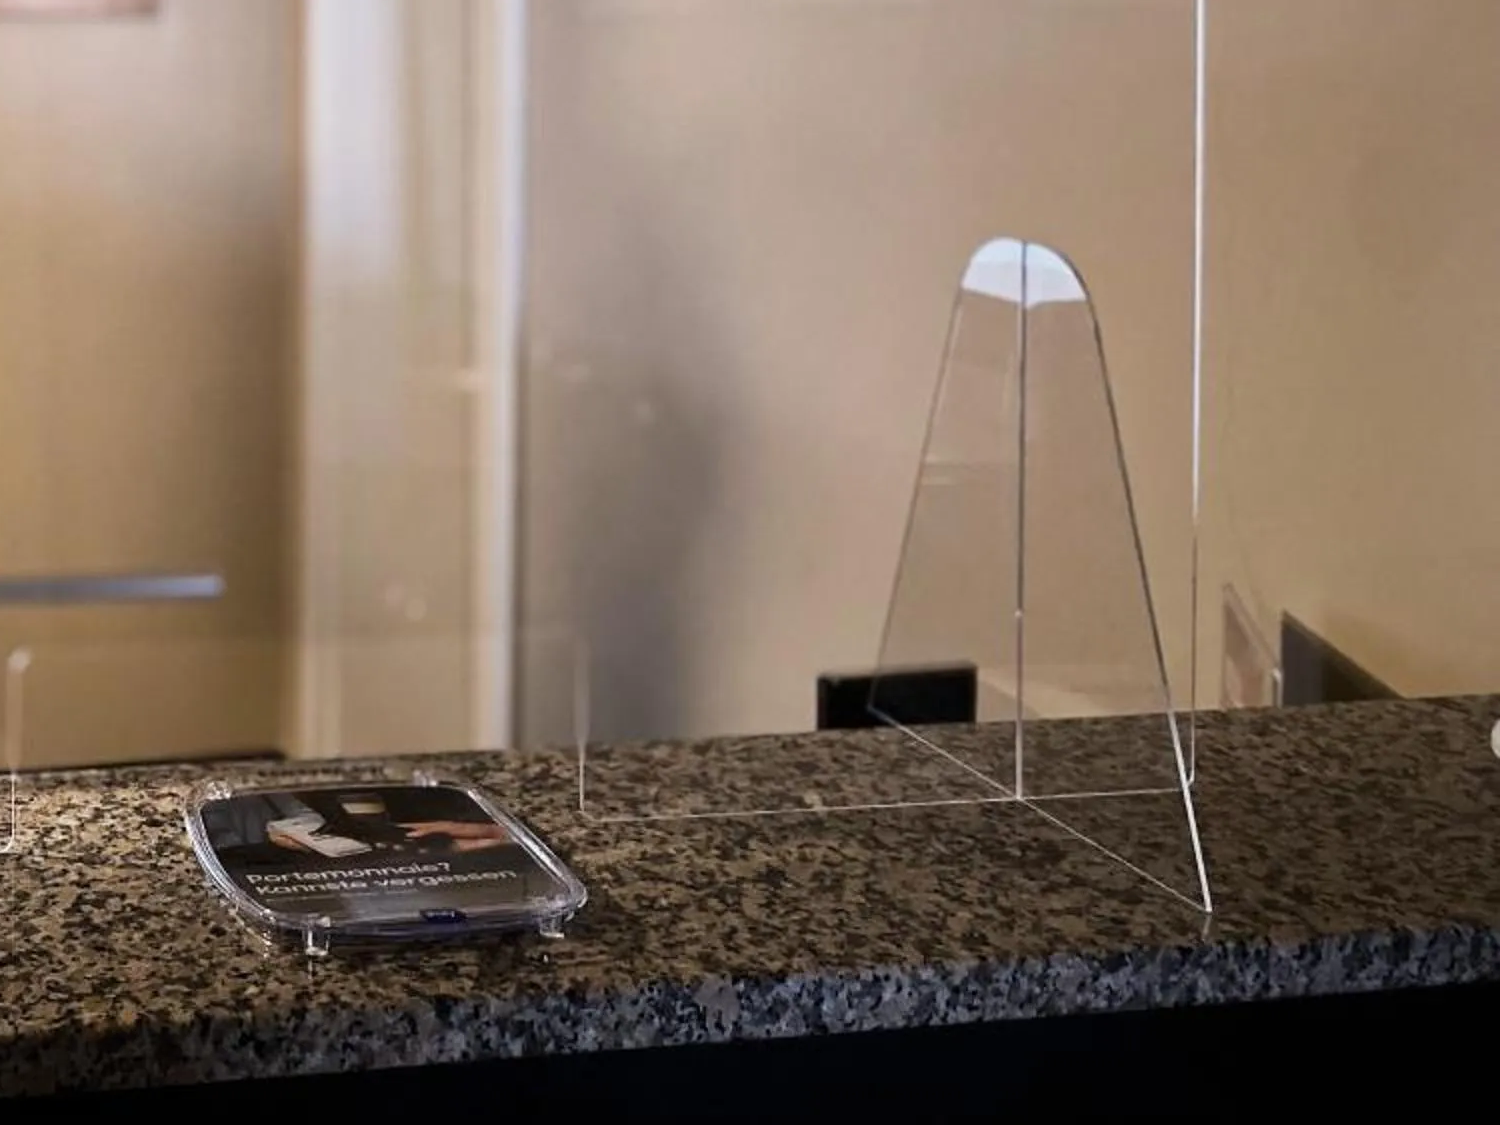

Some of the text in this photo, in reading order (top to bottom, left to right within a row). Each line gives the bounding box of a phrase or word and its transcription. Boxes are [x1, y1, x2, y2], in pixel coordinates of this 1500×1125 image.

[246, 861, 451, 884] Portemonnaie?
[255, 879, 368, 896] Kannste
[372, 869, 517, 887] vergessen
